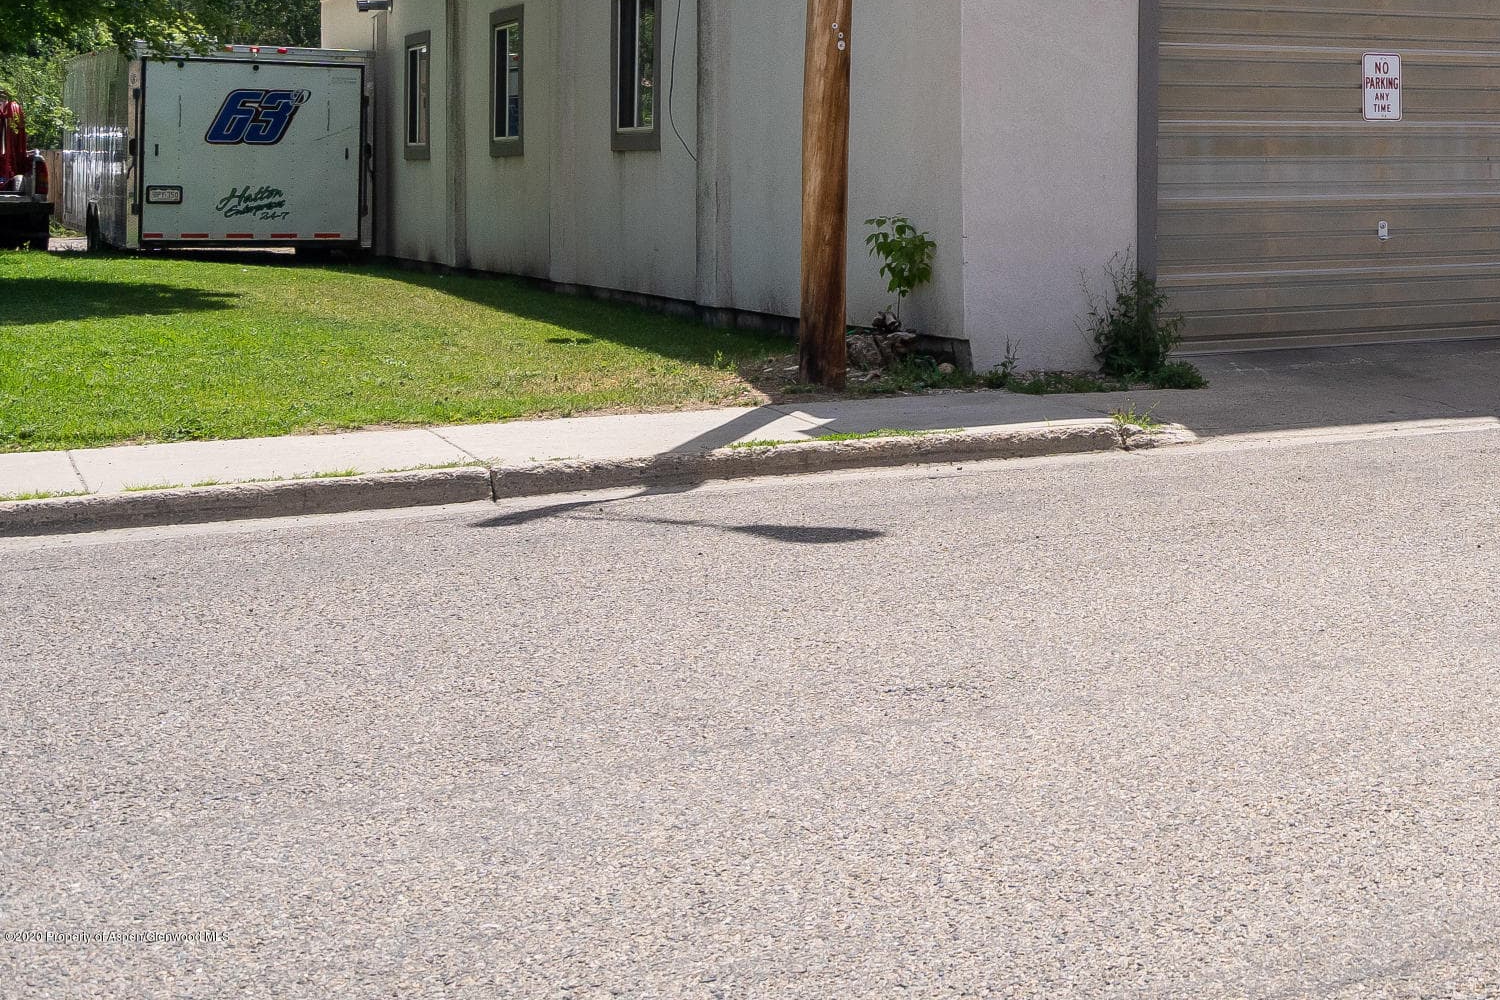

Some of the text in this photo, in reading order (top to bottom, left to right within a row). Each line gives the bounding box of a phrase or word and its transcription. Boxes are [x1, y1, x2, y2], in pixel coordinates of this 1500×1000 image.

[1375, 62, 1389, 74] NO
[1366, 77, 1398, 90] PARKING
[1374, 93, 1390, 102] ANY
[1373, 104, 1392, 113] TIME
[205, 88, 302, 145] 63
